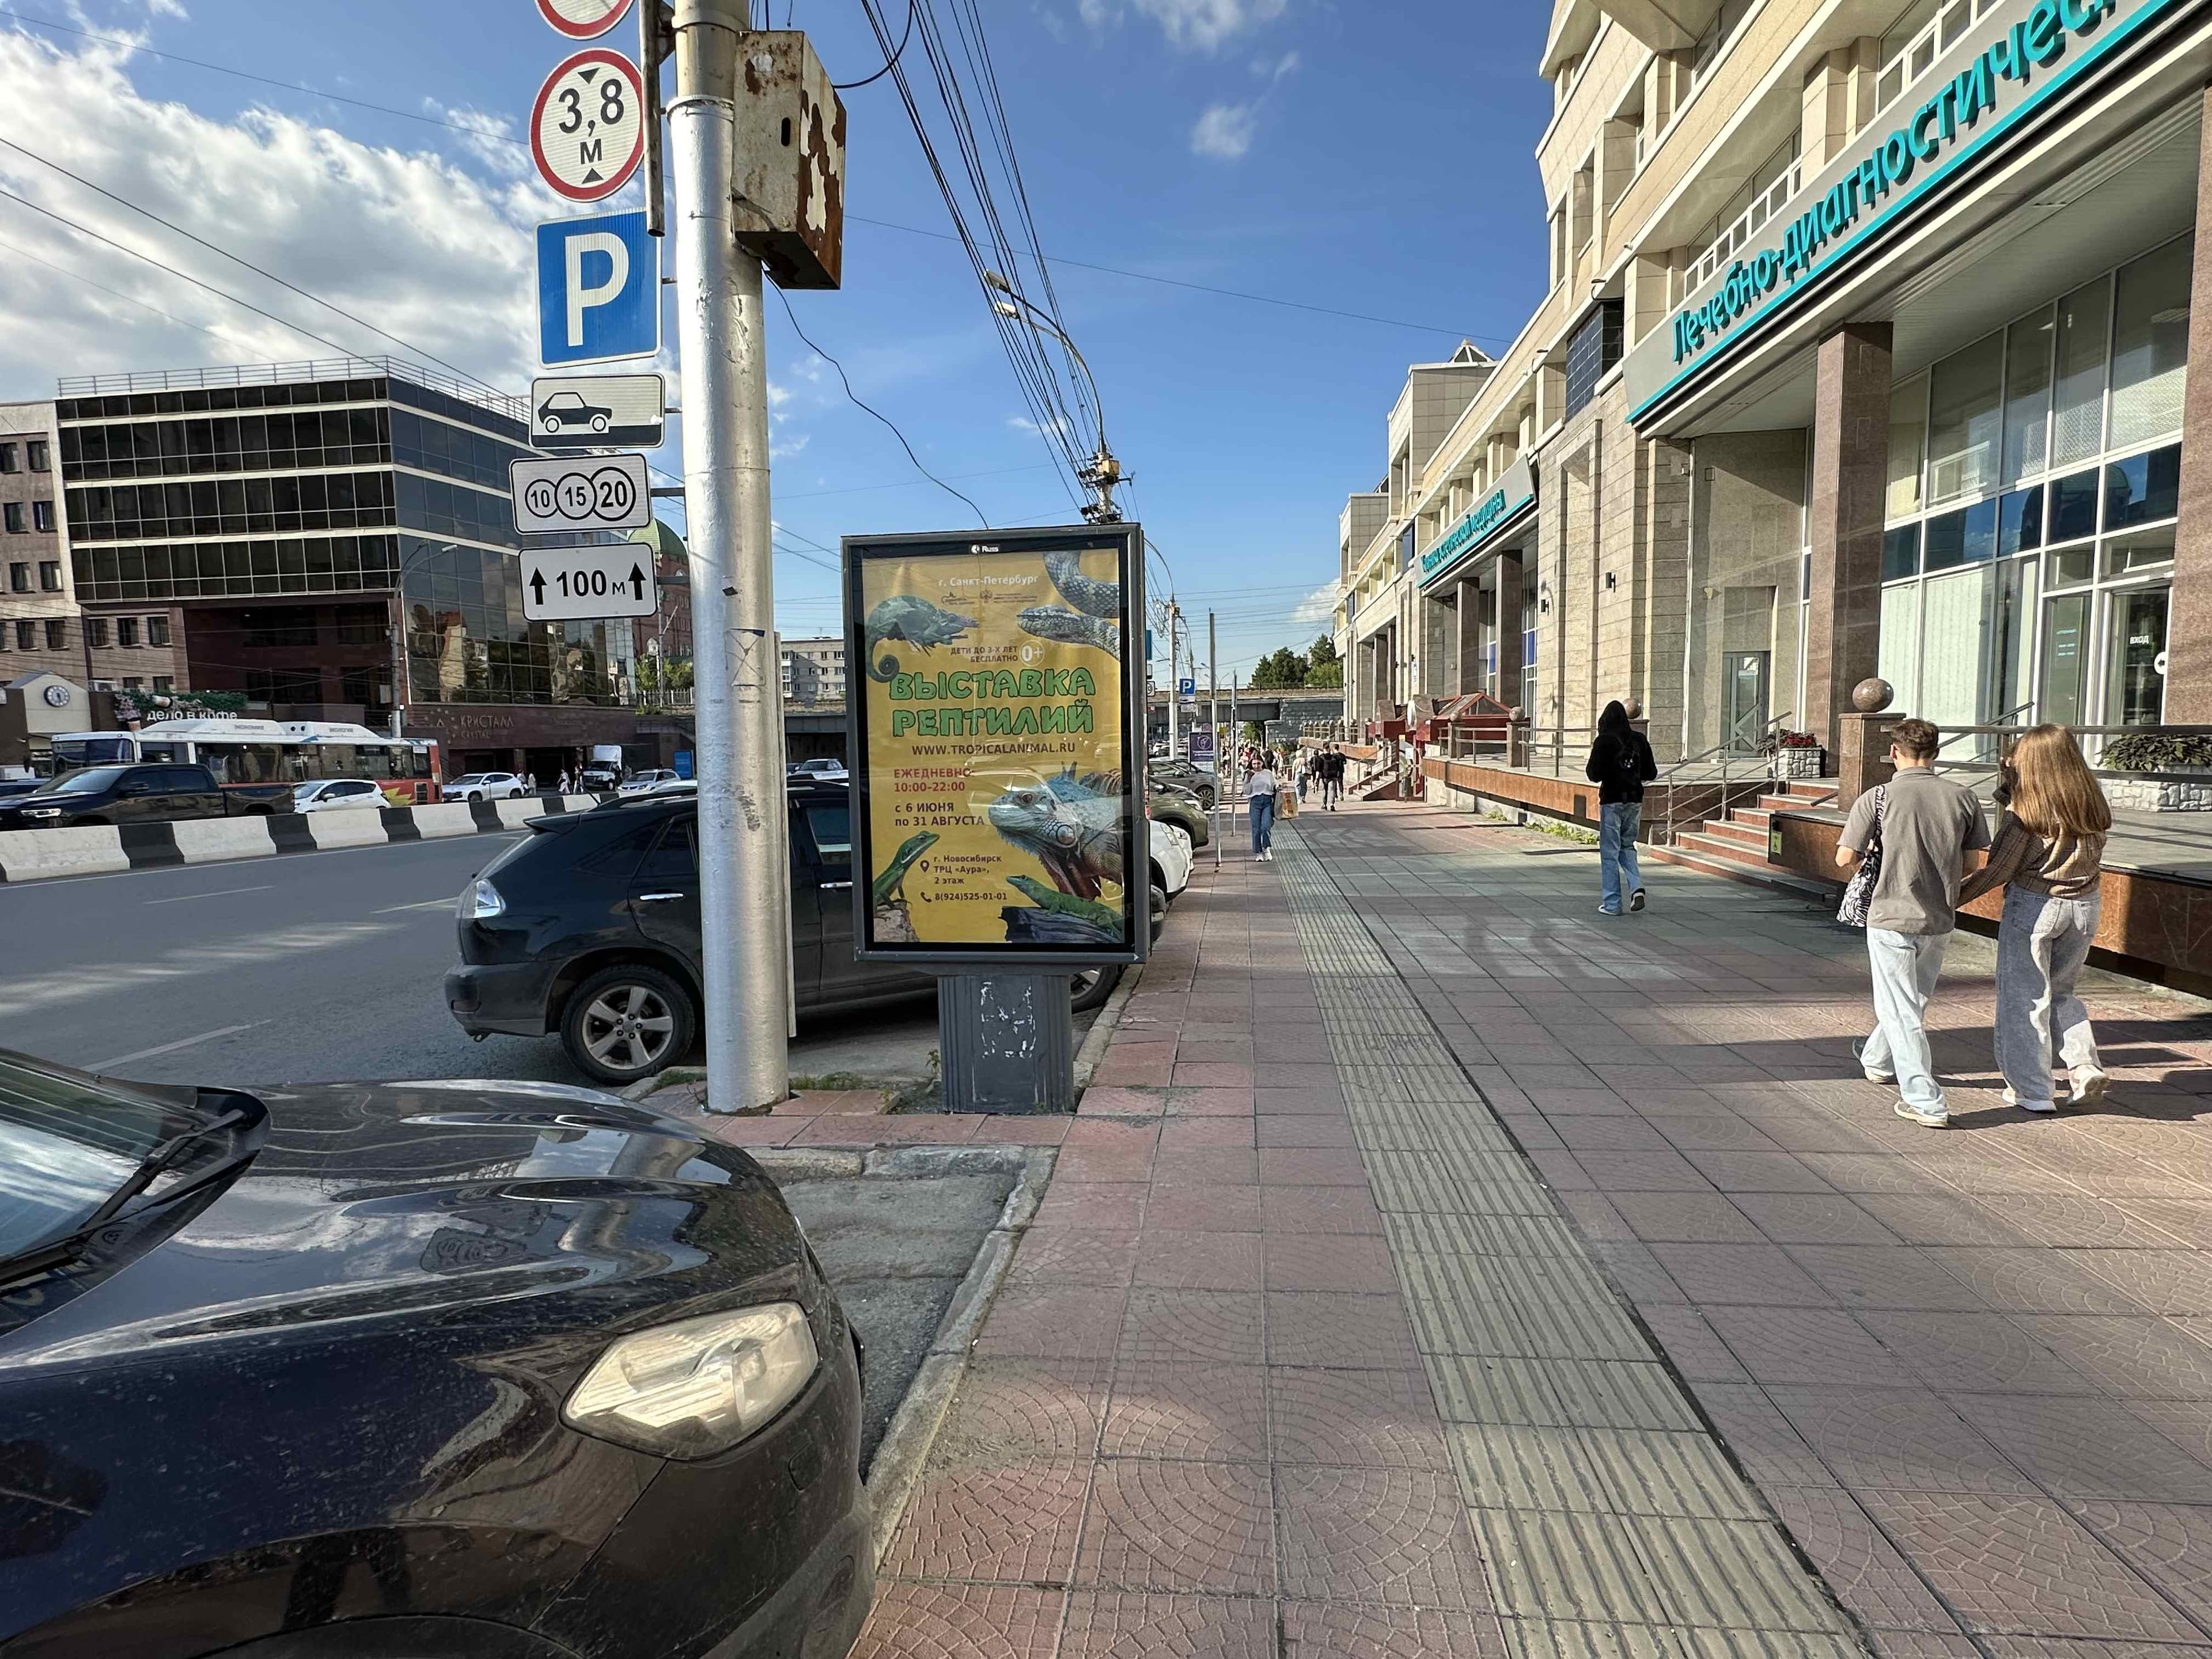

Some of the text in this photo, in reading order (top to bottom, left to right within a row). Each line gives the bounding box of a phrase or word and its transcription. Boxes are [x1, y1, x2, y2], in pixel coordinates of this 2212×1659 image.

[558, 78, 624, 137] 3,8
[1672, 0, 2113, 363] Лечебно-диагностичес
[565, 232, 629, 347] P
[531, 480, 627, 508] 10 15 20
[556, 570, 607, 597] 100
[950, 574, 1039, 586] Санкт-Петербург
[2130, 635, 2149, 645] ВХОД
[950, 647, 971, 655] ДЕТИ
[974, 646, 986, 654] ДО
[1002, 645, 1018, 653] ЛЕТ
[970, 654, 1018, 663] БЕСПЛАТНО
[889, 668, 1095, 700] ВЫСТАВКА
[1182, 680, 1192, 694] P
[461, 715, 514, 728] КРИСТАЛЛ
[892, 699, 1094, 737] РЕПТИЛИЙ
[912, 743, 1075, 755] WWW.TROPICALANIMAL.RU
[894, 781, 965, 792] 10:00-22:00
[906, 803, 912, 812] 6
[917, 802, 954, 812] ИЮНЯ
[895, 816, 984, 826] по 31 АВГУСТА
[944, 855, 1001, 863] Новосибирск
[934, 866, 952, 874] ТРЦ
[935, 893, 1007, 901] 8(924)525-01-01
